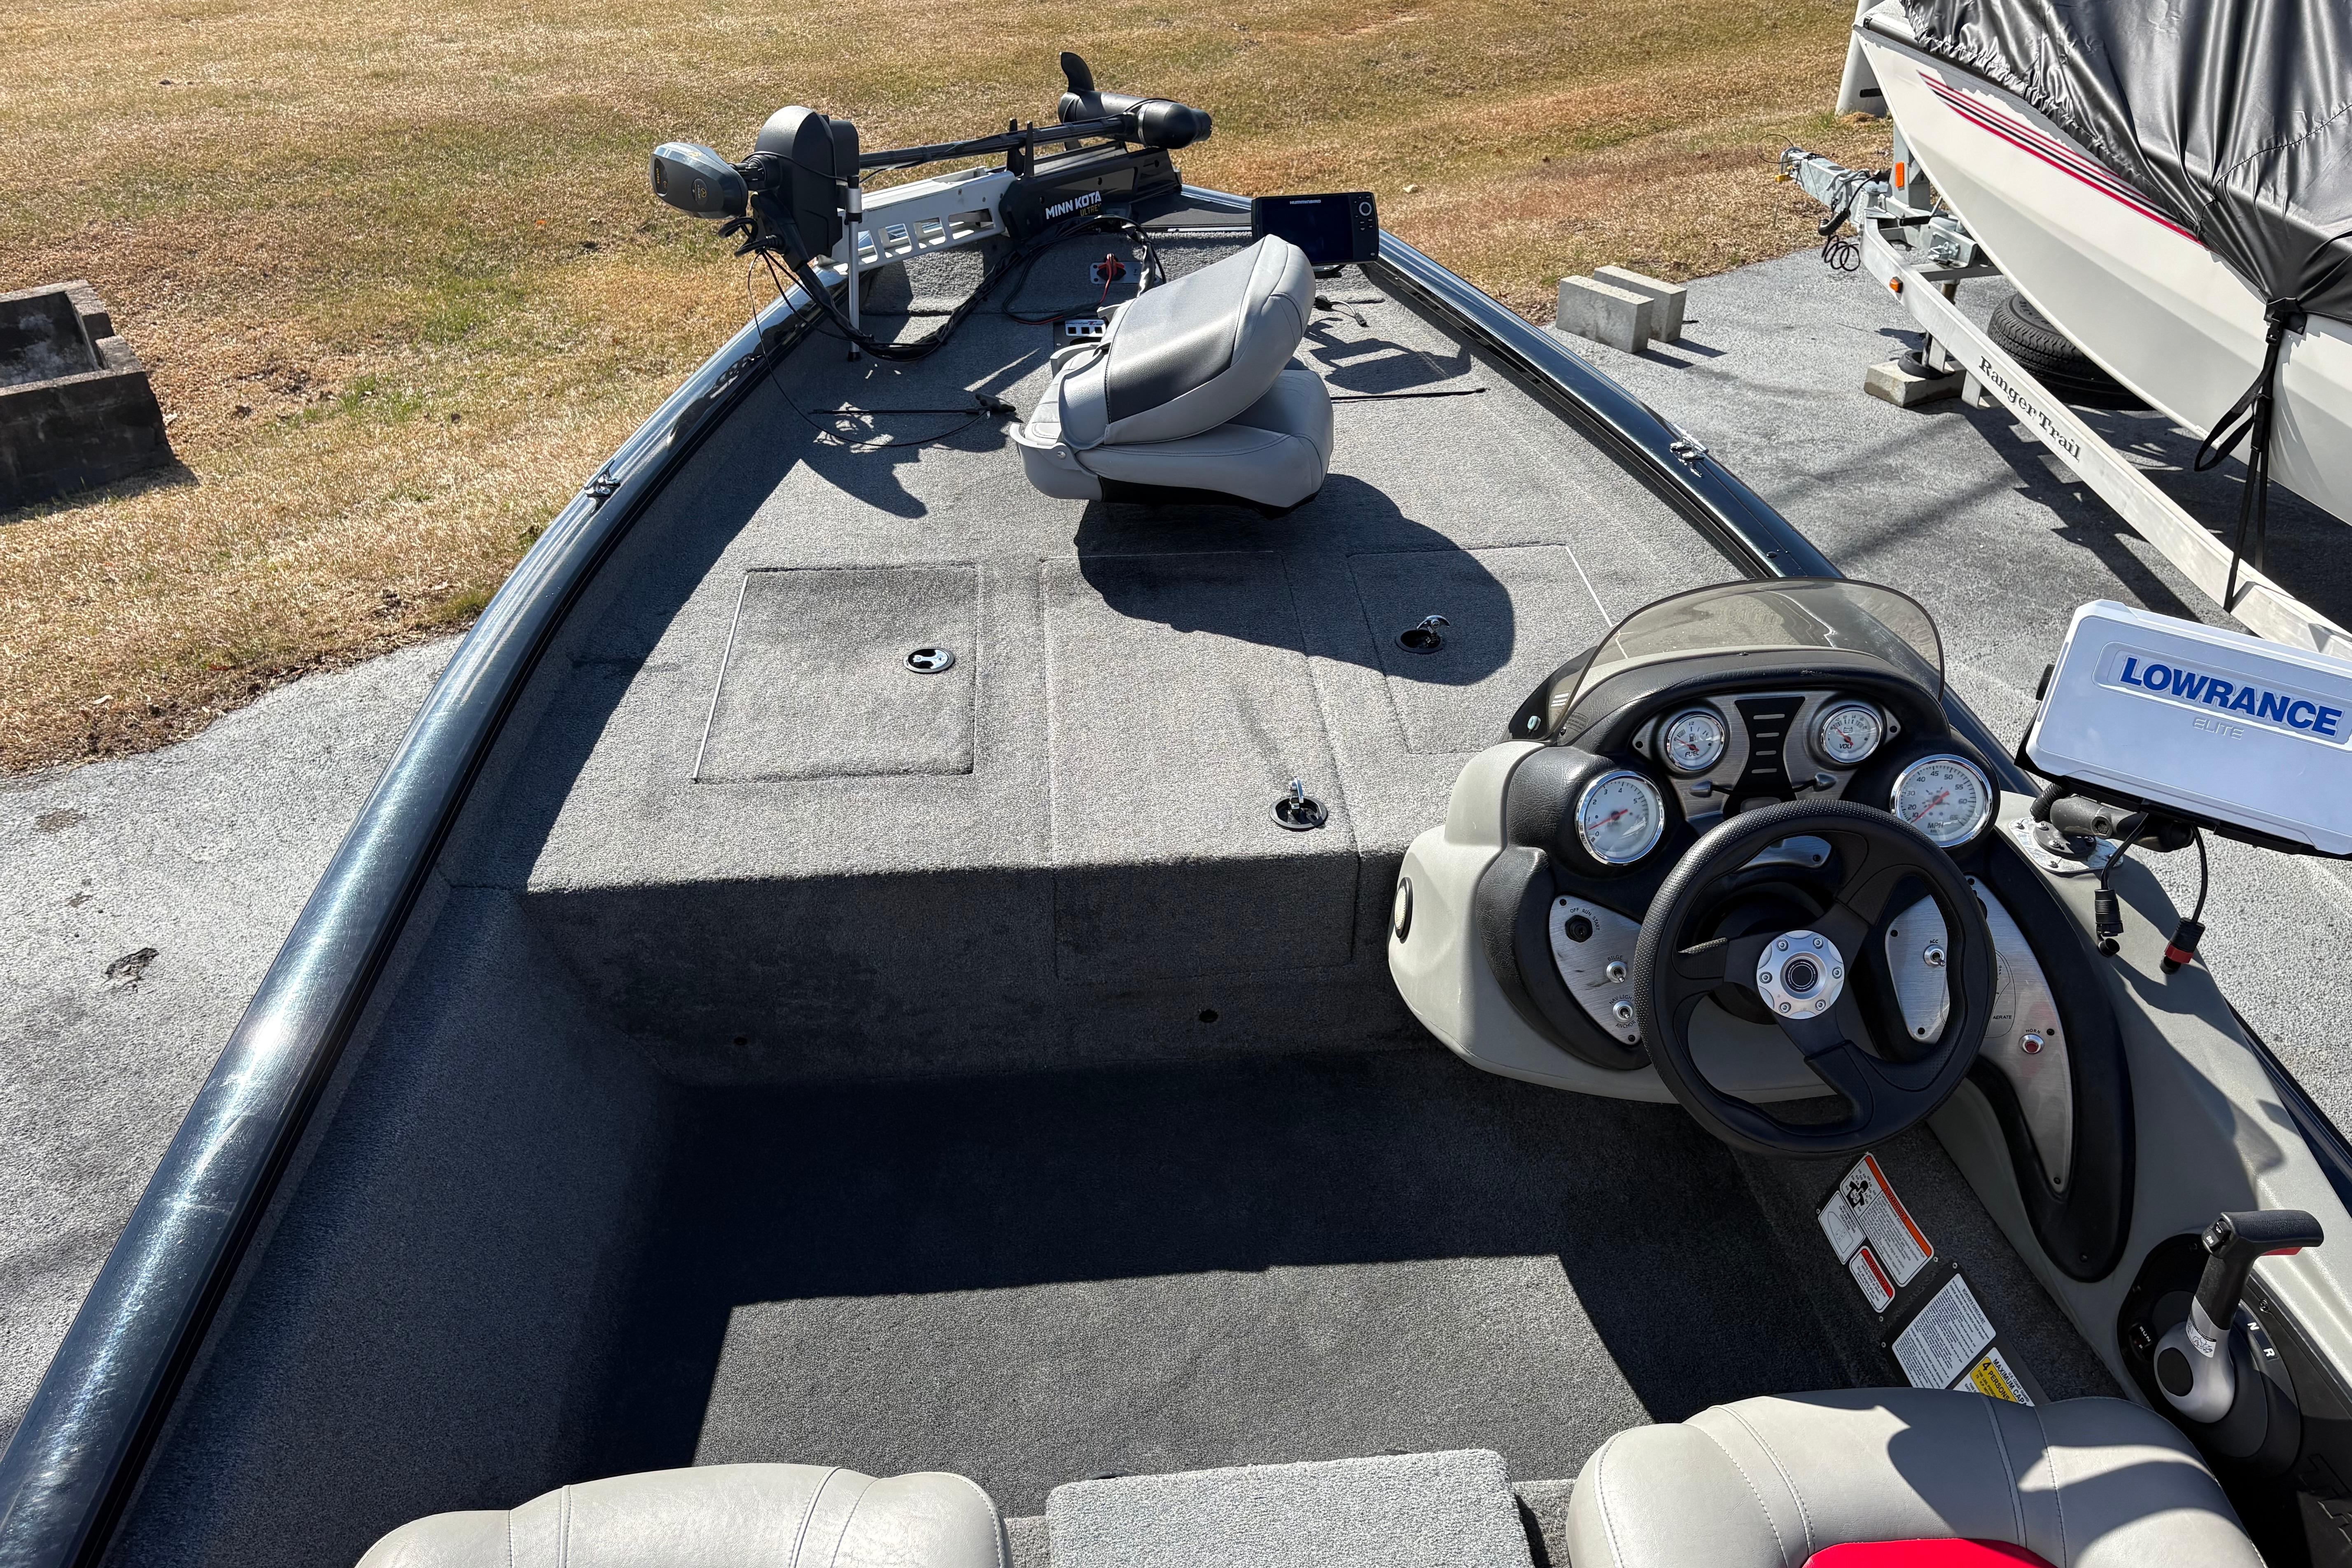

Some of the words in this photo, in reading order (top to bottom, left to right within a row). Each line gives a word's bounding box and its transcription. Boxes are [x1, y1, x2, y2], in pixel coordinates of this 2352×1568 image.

[1045, 200, 1073, 219] MINN
[1075, 191, 1101, 209] KOTA
[1979, 355, 2036, 417] Ranger
[2039, 411, 2080, 460] Trail
[2121, 658, 2342, 735] LOWRANCE
[2192, 718, 2245, 740] ELITE
[1615, 1020, 1636, 1028] ANCHOR
[1888, 1192, 1904, 1217] WARNING
[2140, 1326, 2151, 1342] RUN
[2263, 1348, 2275, 1357] R
[1982, 1361, 1991, 1371] 4
[1993, 1358, 2014, 1389] MAXIMUM
[2012, 1379, 2021, 1389] COAST
[2020, 1390, 2029, 1402] GUARD
